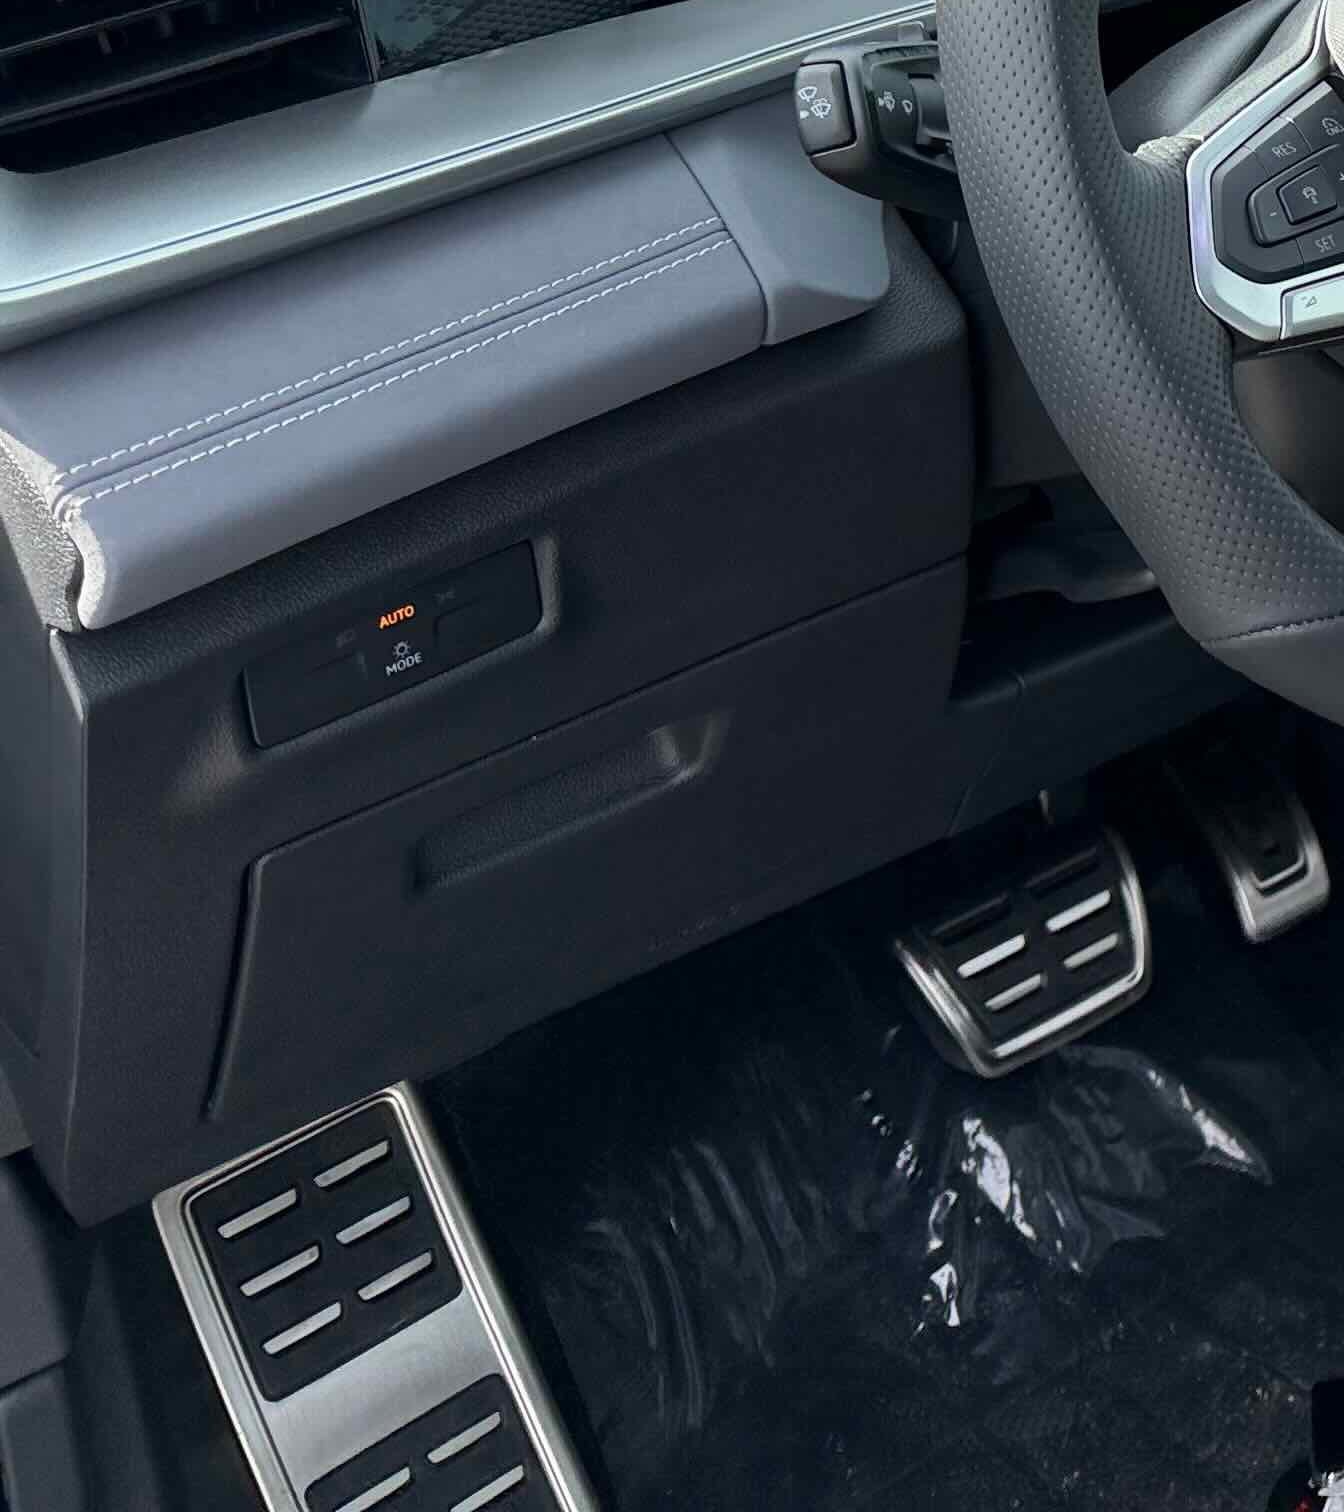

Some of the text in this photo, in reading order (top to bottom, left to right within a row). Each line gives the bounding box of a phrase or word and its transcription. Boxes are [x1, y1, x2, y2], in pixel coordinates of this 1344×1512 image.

[1271, 141, 1298, 159] RES
[1314, 233, 1337, 254] SET
[379, 604, 415, 630] AUTO
[385, 652, 423, 676] MODE
